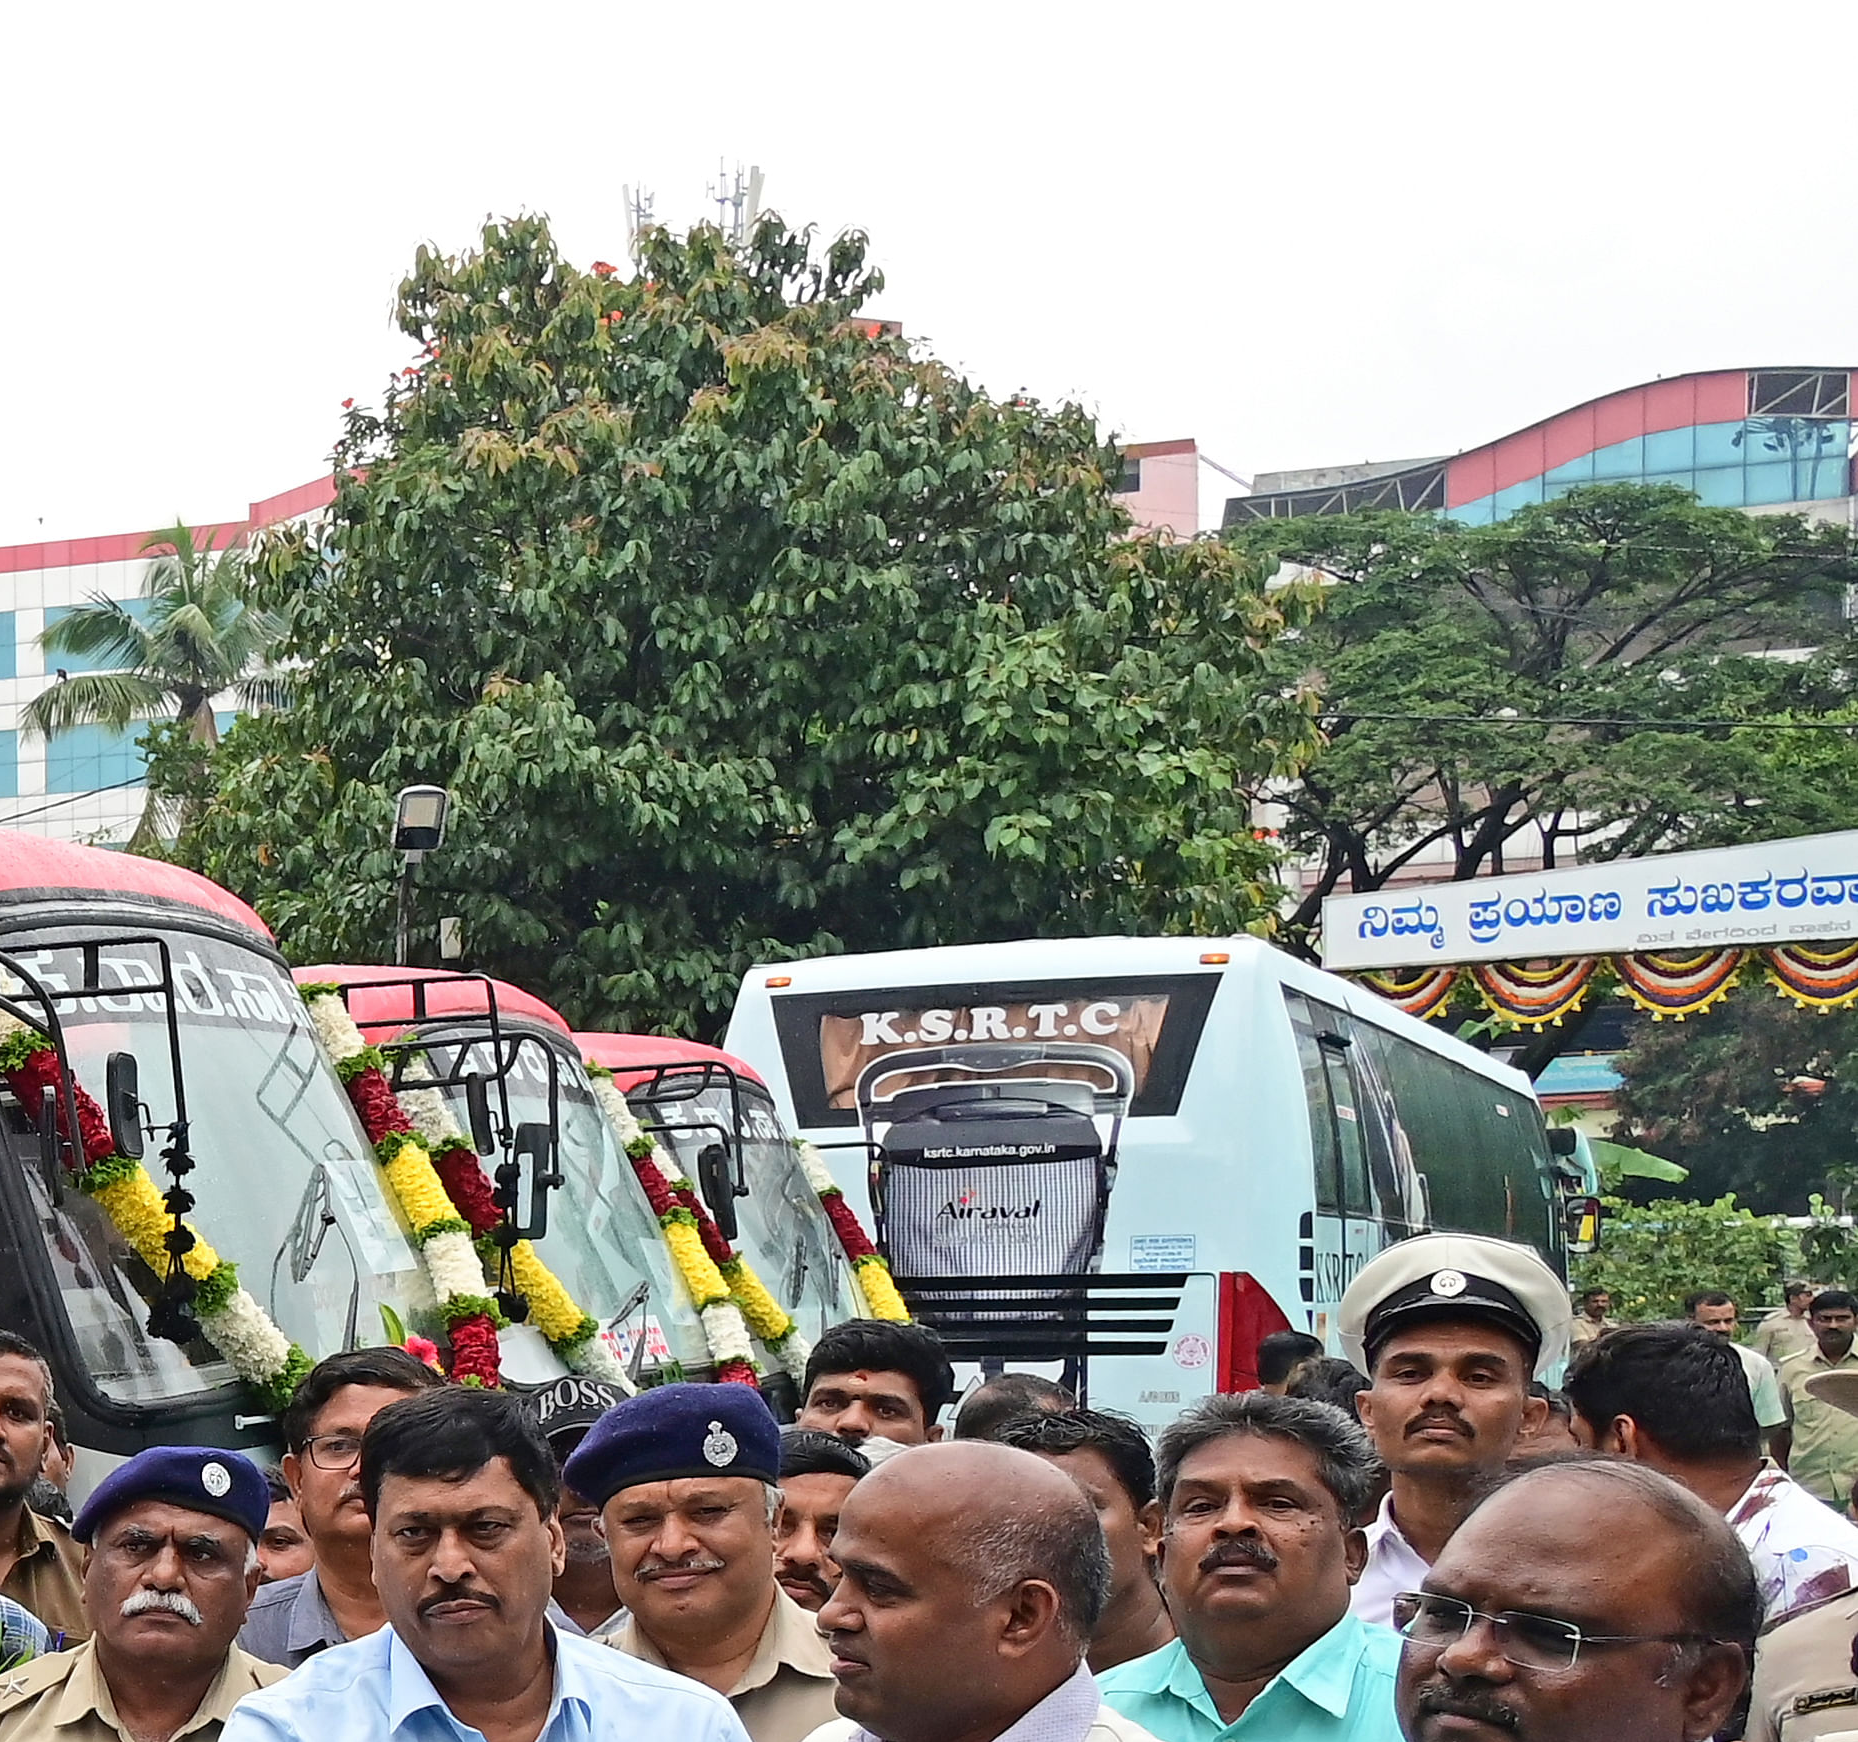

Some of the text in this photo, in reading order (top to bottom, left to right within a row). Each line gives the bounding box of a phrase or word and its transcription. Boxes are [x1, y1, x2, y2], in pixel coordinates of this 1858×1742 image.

[1358, 895, 1447, 950] ನಿಮ್ಮ
[1468, 887, 1622, 945] ಪ್ರಯಾಣ
[1789, 919, 1852, 935] ವಾಹನ
[859, 1001, 1121, 1046] K.S.R.T.C
[923, 1143, 1057, 1159] ksrtc.karnataka.gov.in
[537, 1378, 618, 1421] BOSS
